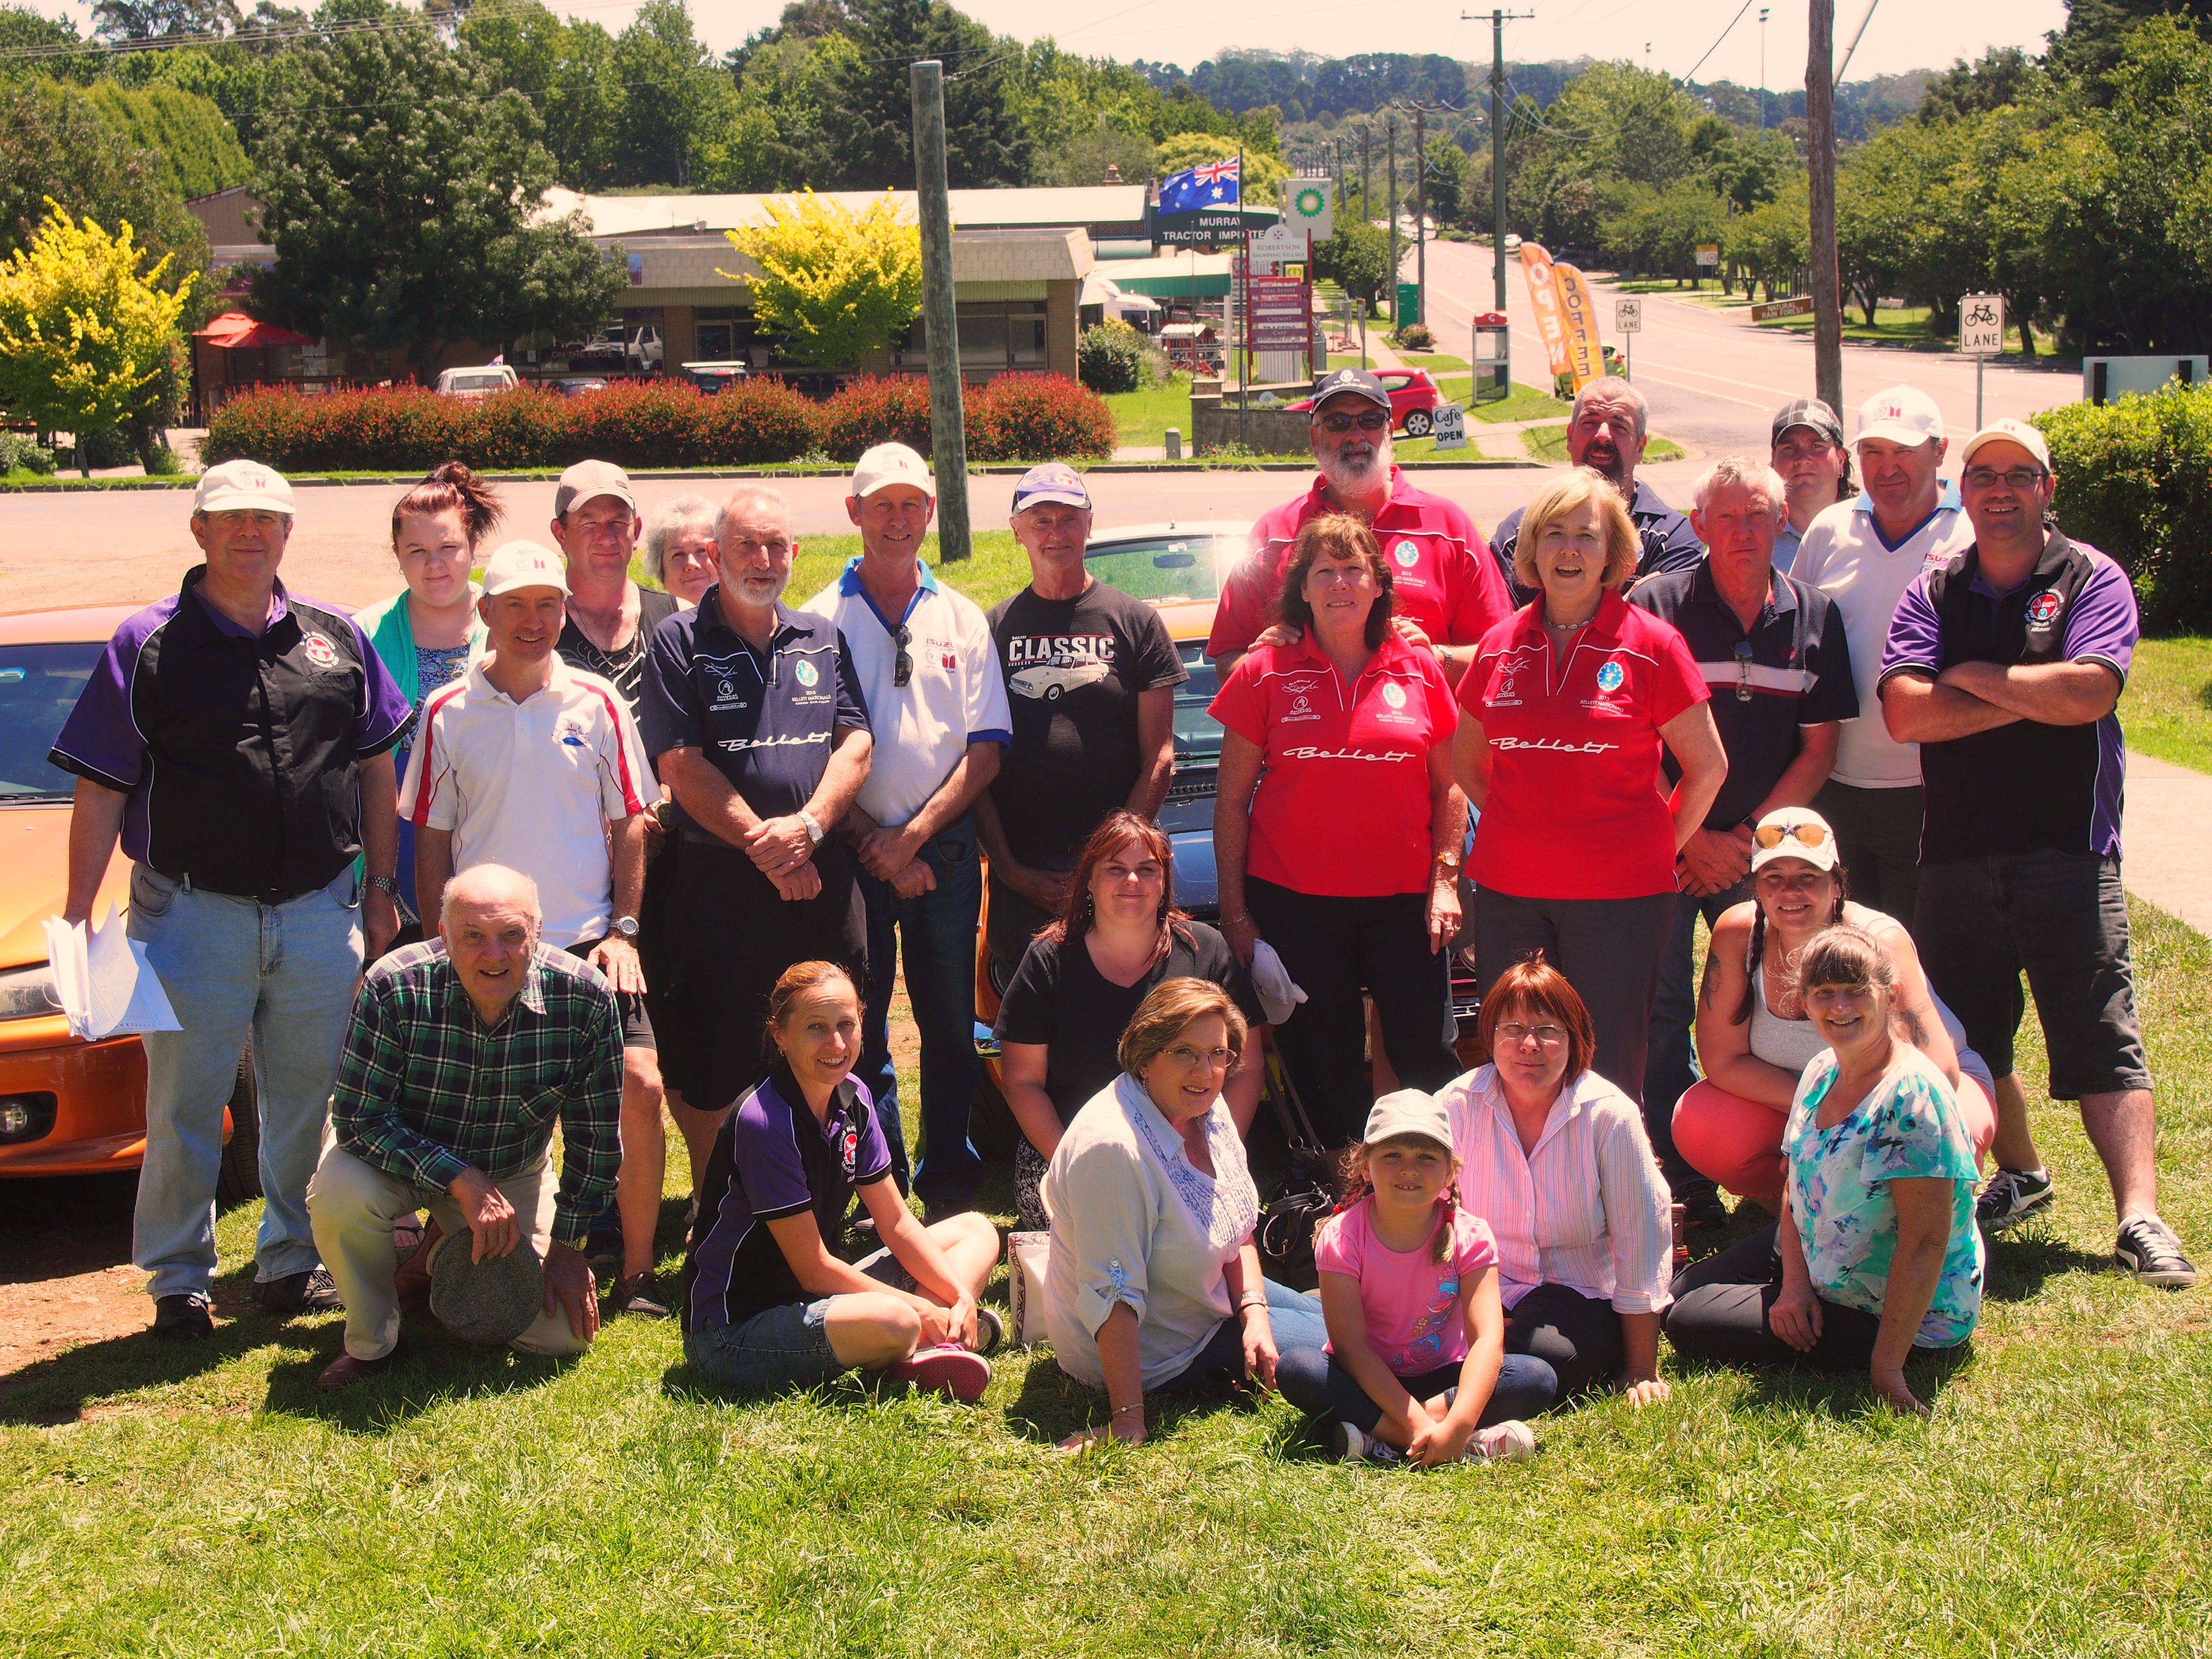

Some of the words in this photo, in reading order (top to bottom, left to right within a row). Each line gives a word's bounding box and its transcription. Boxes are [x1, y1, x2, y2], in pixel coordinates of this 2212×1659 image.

[1163, 231, 1211, 240] TRACTOR
[1761, 311, 1778, 319] RAIN
[1779, 307, 1804, 316] FOREST
[1767, 302, 1797, 312] NATURAL
[1964, 334, 1998, 347] LANE
[1435, 409, 1461, 426] Cafe
[1437, 430, 1463, 442] OPEN
[2045, 588, 2064, 603] Nationals
[2024, 613, 2049, 626] Merimbula
[1009, 637, 1114, 661] CLASSIC
[1598, 701, 1624, 712] NATIONALS
[718, 732, 832, 752] Bellett
[1489, 737, 1620, 754] Bellett
[1282, 746, 1417, 762] Bellett
[838, 1130, 847, 1152] Bellett
